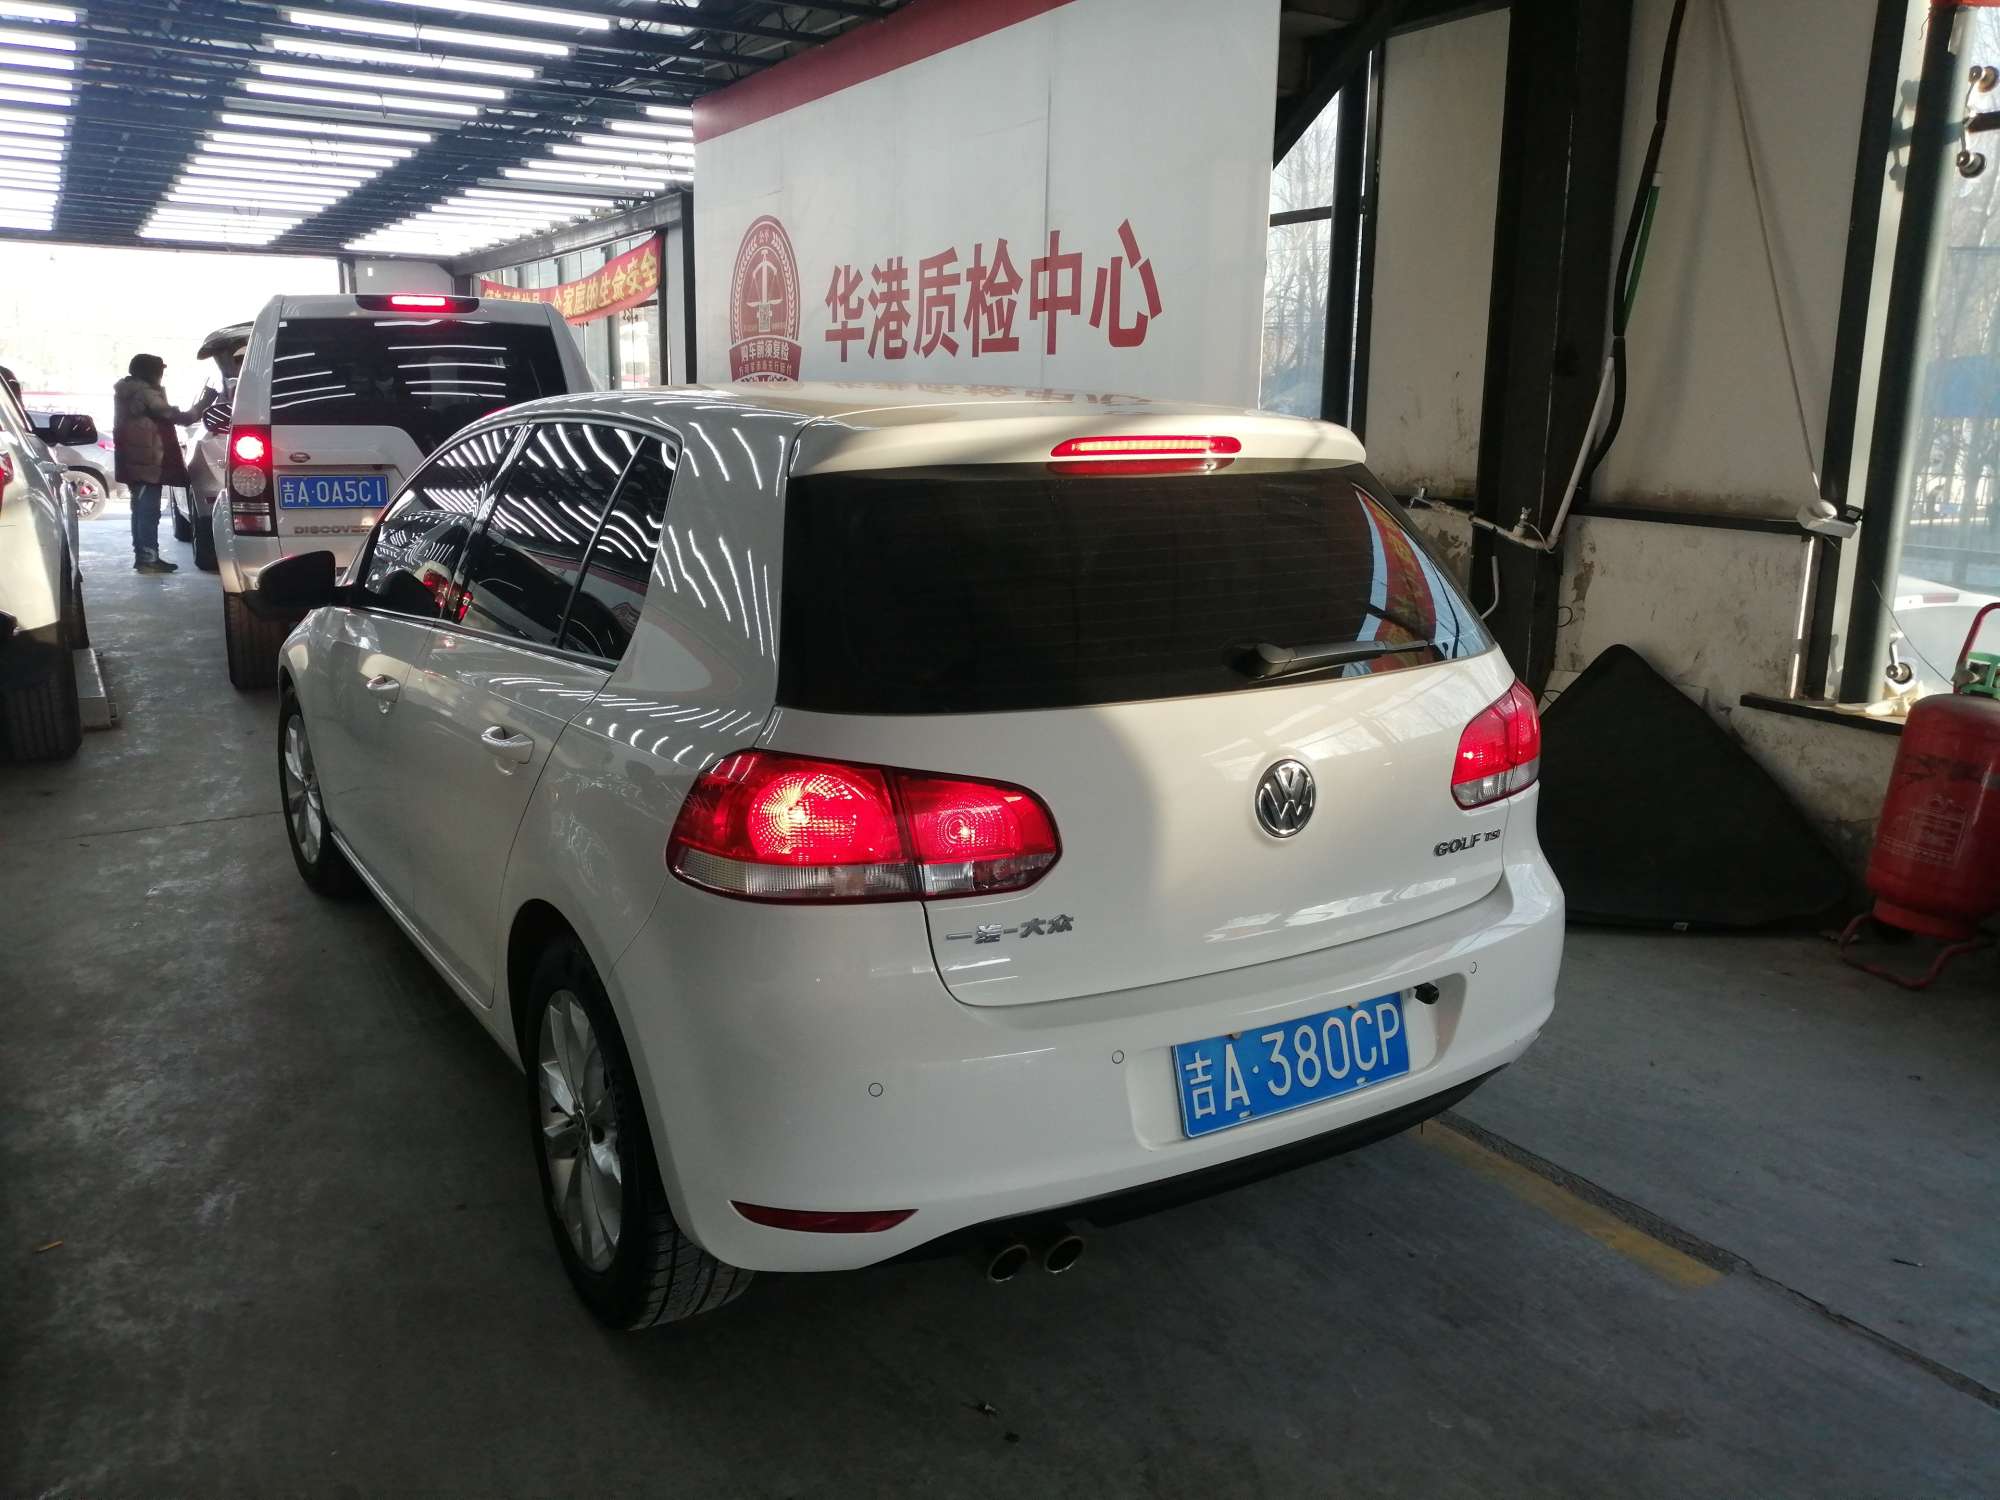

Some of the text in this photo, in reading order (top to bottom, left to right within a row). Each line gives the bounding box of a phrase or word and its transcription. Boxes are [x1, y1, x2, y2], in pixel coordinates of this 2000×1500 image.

[824, 218, 1163, 363] 华港质检中心
[1433, 828, 1502, 857] GOLF TSI
[1185, 1002, 1400, 1120] 吉A·380CP
